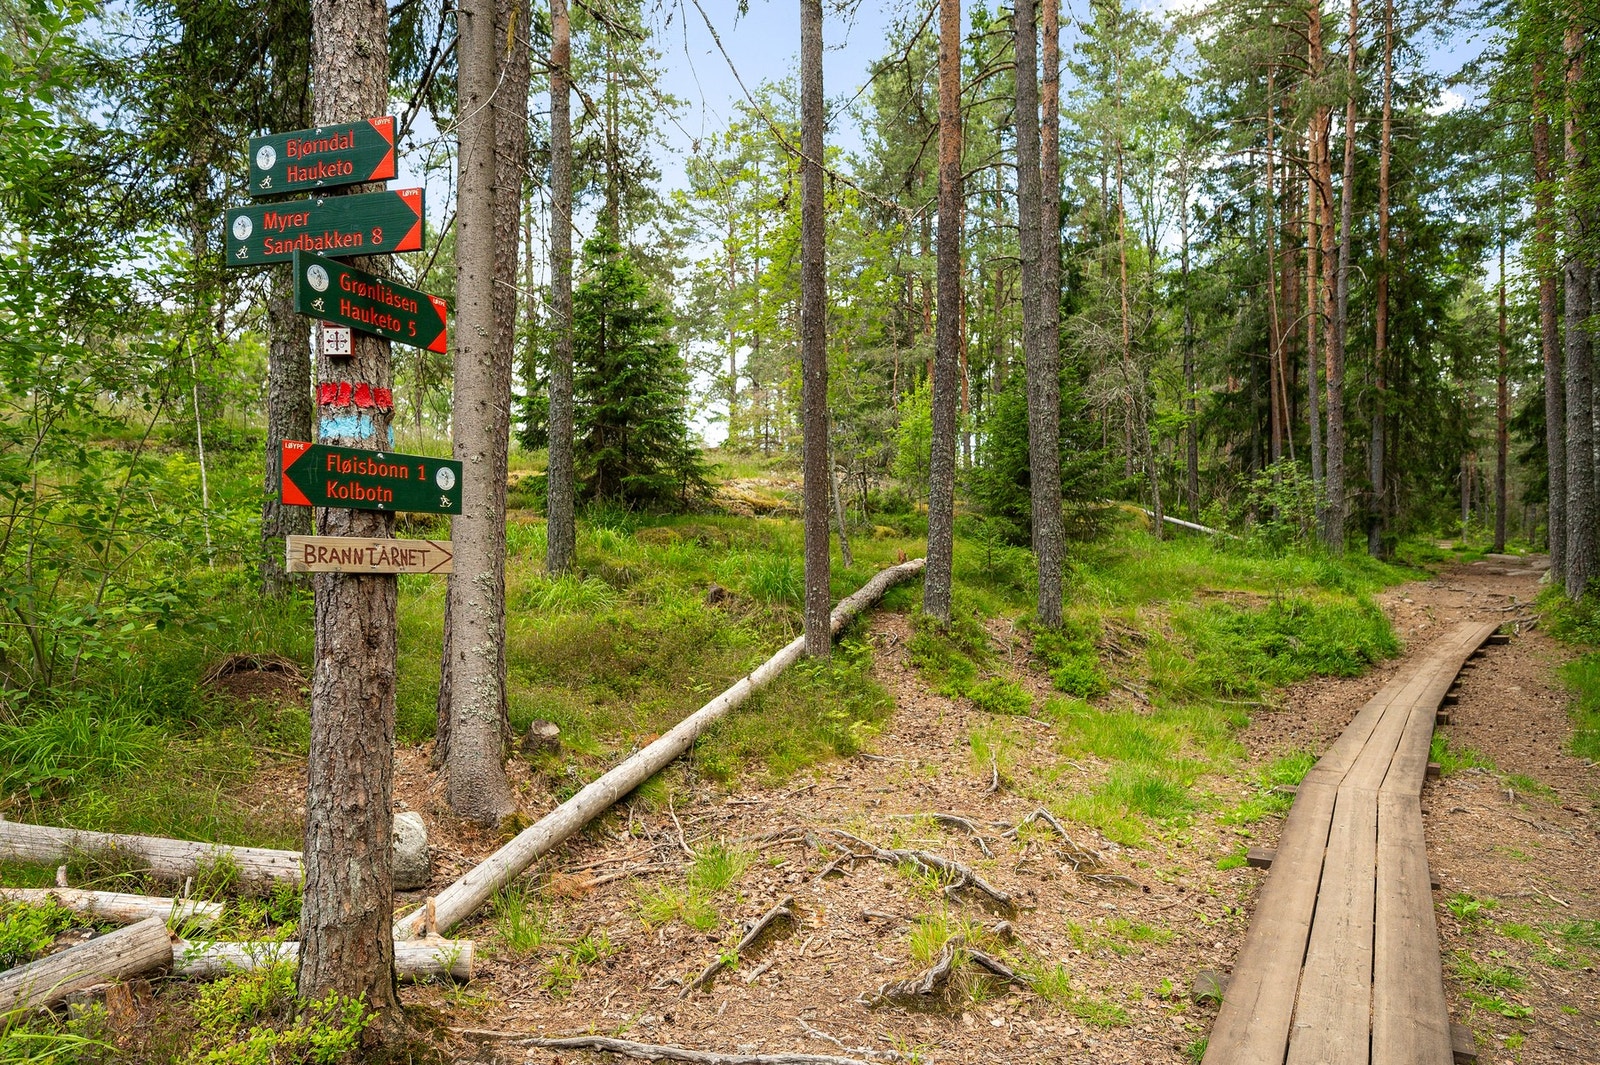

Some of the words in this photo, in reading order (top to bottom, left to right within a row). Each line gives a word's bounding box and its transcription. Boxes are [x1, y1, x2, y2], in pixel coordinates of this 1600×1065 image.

[287, 130, 355, 161] Bjørndal
[287, 161, 353, 183] Hauketo
[264, 211, 310, 232] Myrer
[264, 230, 363, 255] Sandbakken
[371, 228, 383, 245] 8
[339, 272, 418, 313] Grønliåsen
[340, 299, 401, 333] Hauketo
[408, 321, 416, 337] 5
[284, 442, 304, 450] LØYPE
[326, 454, 409, 479] Fløisbonn
[418, 466, 426, 480] 1
[327, 481, 393, 503] Kolbotn
